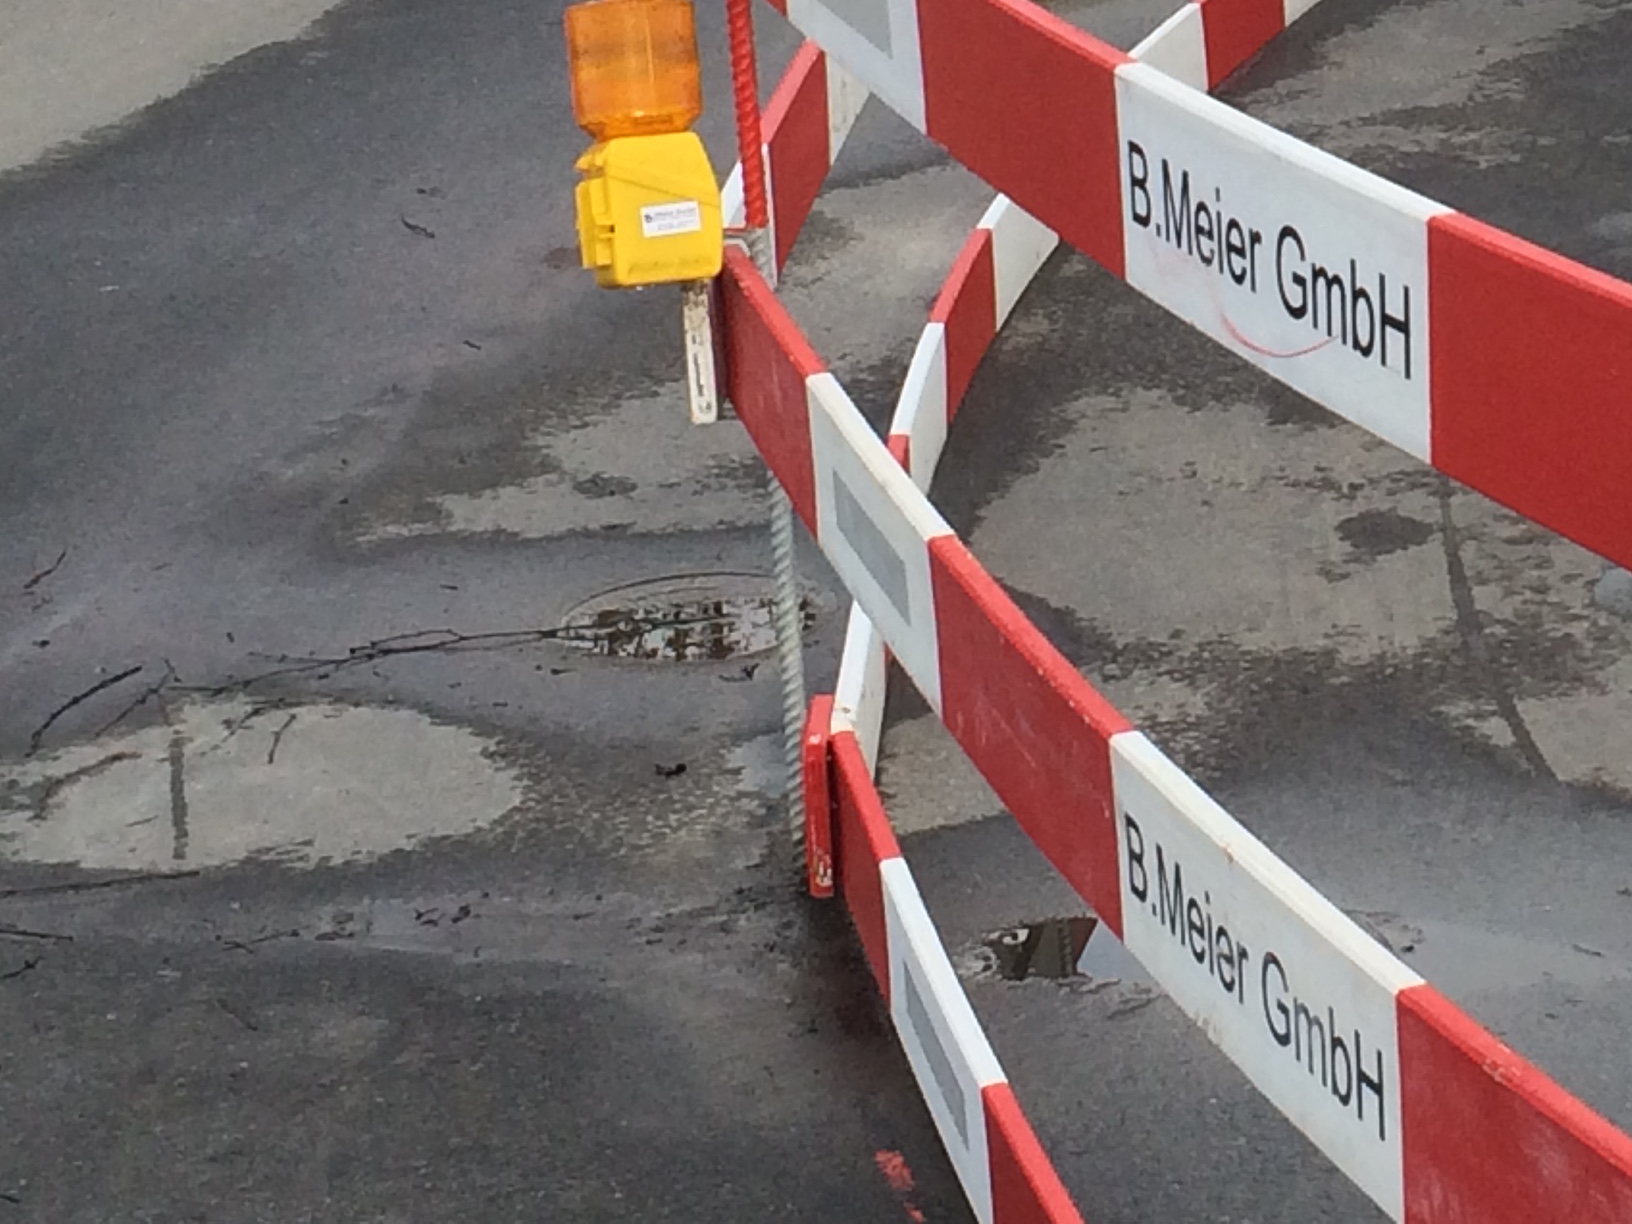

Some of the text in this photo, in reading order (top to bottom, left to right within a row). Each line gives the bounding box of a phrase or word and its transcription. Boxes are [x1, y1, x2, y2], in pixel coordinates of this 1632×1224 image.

[1127, 139, 1412, 380] B.Meier GmbH
[1124, 811, 1386, 1142] B.Meier GmbH
